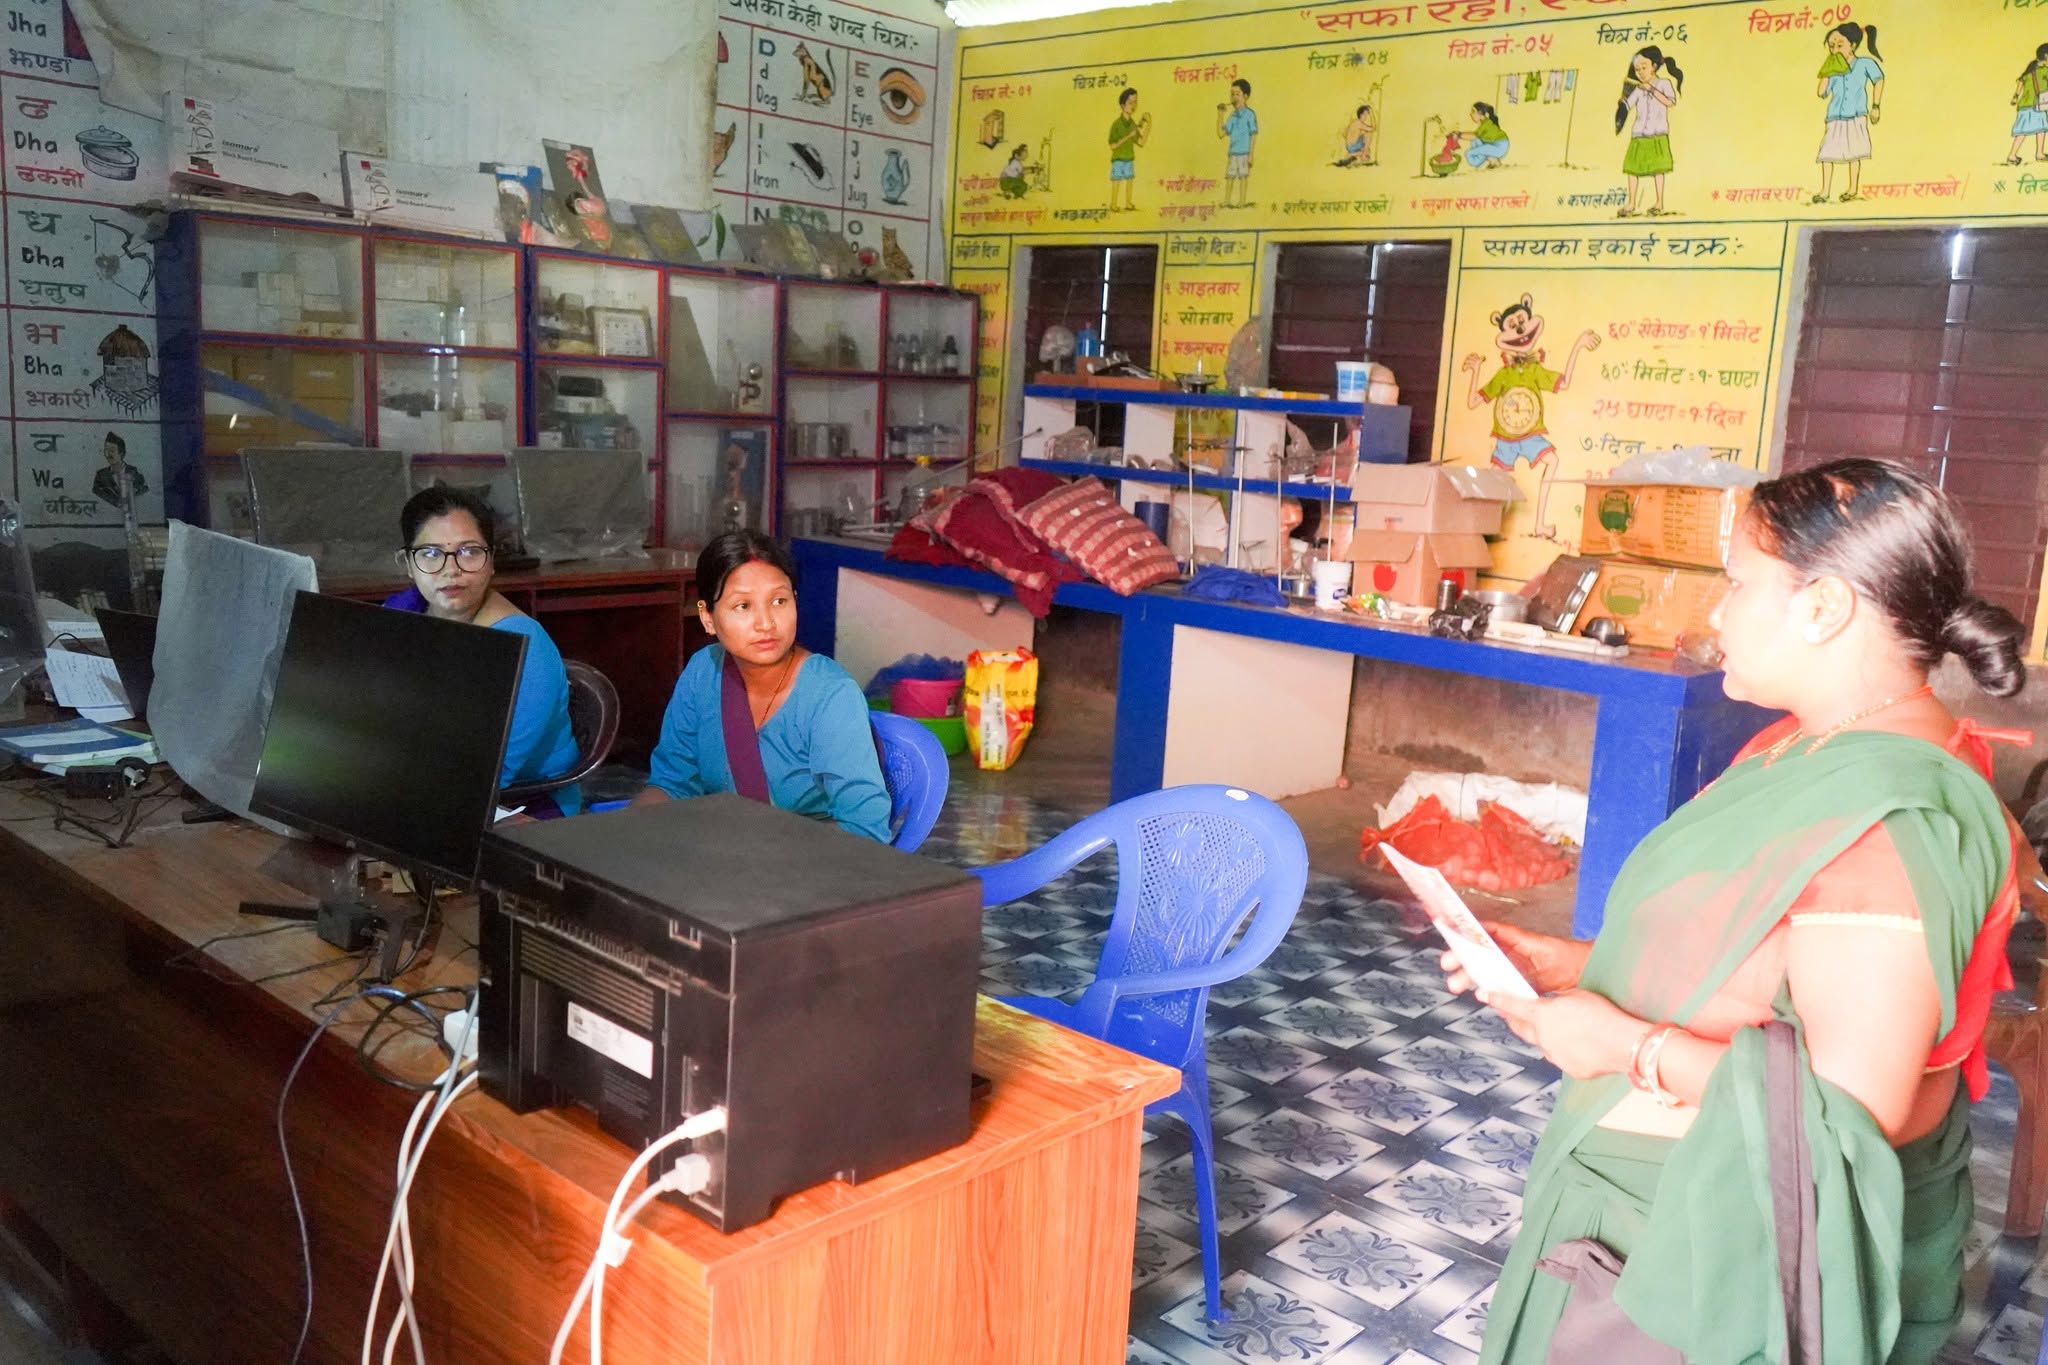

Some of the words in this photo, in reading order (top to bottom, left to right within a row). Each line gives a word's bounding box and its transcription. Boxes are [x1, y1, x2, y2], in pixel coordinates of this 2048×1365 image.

[8, 10, 46, 38] Jha
[1748, 8, 1792, 33] चित्र
[1597, 22, 1629, 46] चित्र
[759, 38, 776, 57] D
[1448, 38, 1484, 60] चित्र
[760, 62, 769, 80] d
[854, 61, 871, 78] E
[1308, 50, 1342, 70] चित्र
[1174, 66, 1202, 84] चित्र
[756, 84, 779, 112] Dog
[854, 84, 866, 98] e
[851, 104, 874, 128] Eye
[14, 130, 58, 154] Dha
[851, 140, 860, 158] J
[753, 171, 779, 190] Iron
[853, 162, 861, 180] j
[847, 185, 868, 210] Jug
[18, 210, 62, 236] ध
[848, 220, 863, 236] O
[1588, 232, 1660, 262] इकाई
[19, 279, 88, 304] धनुष
[24, 355, 63, 376] Bha
[32, 468, 64, 490] Wa
